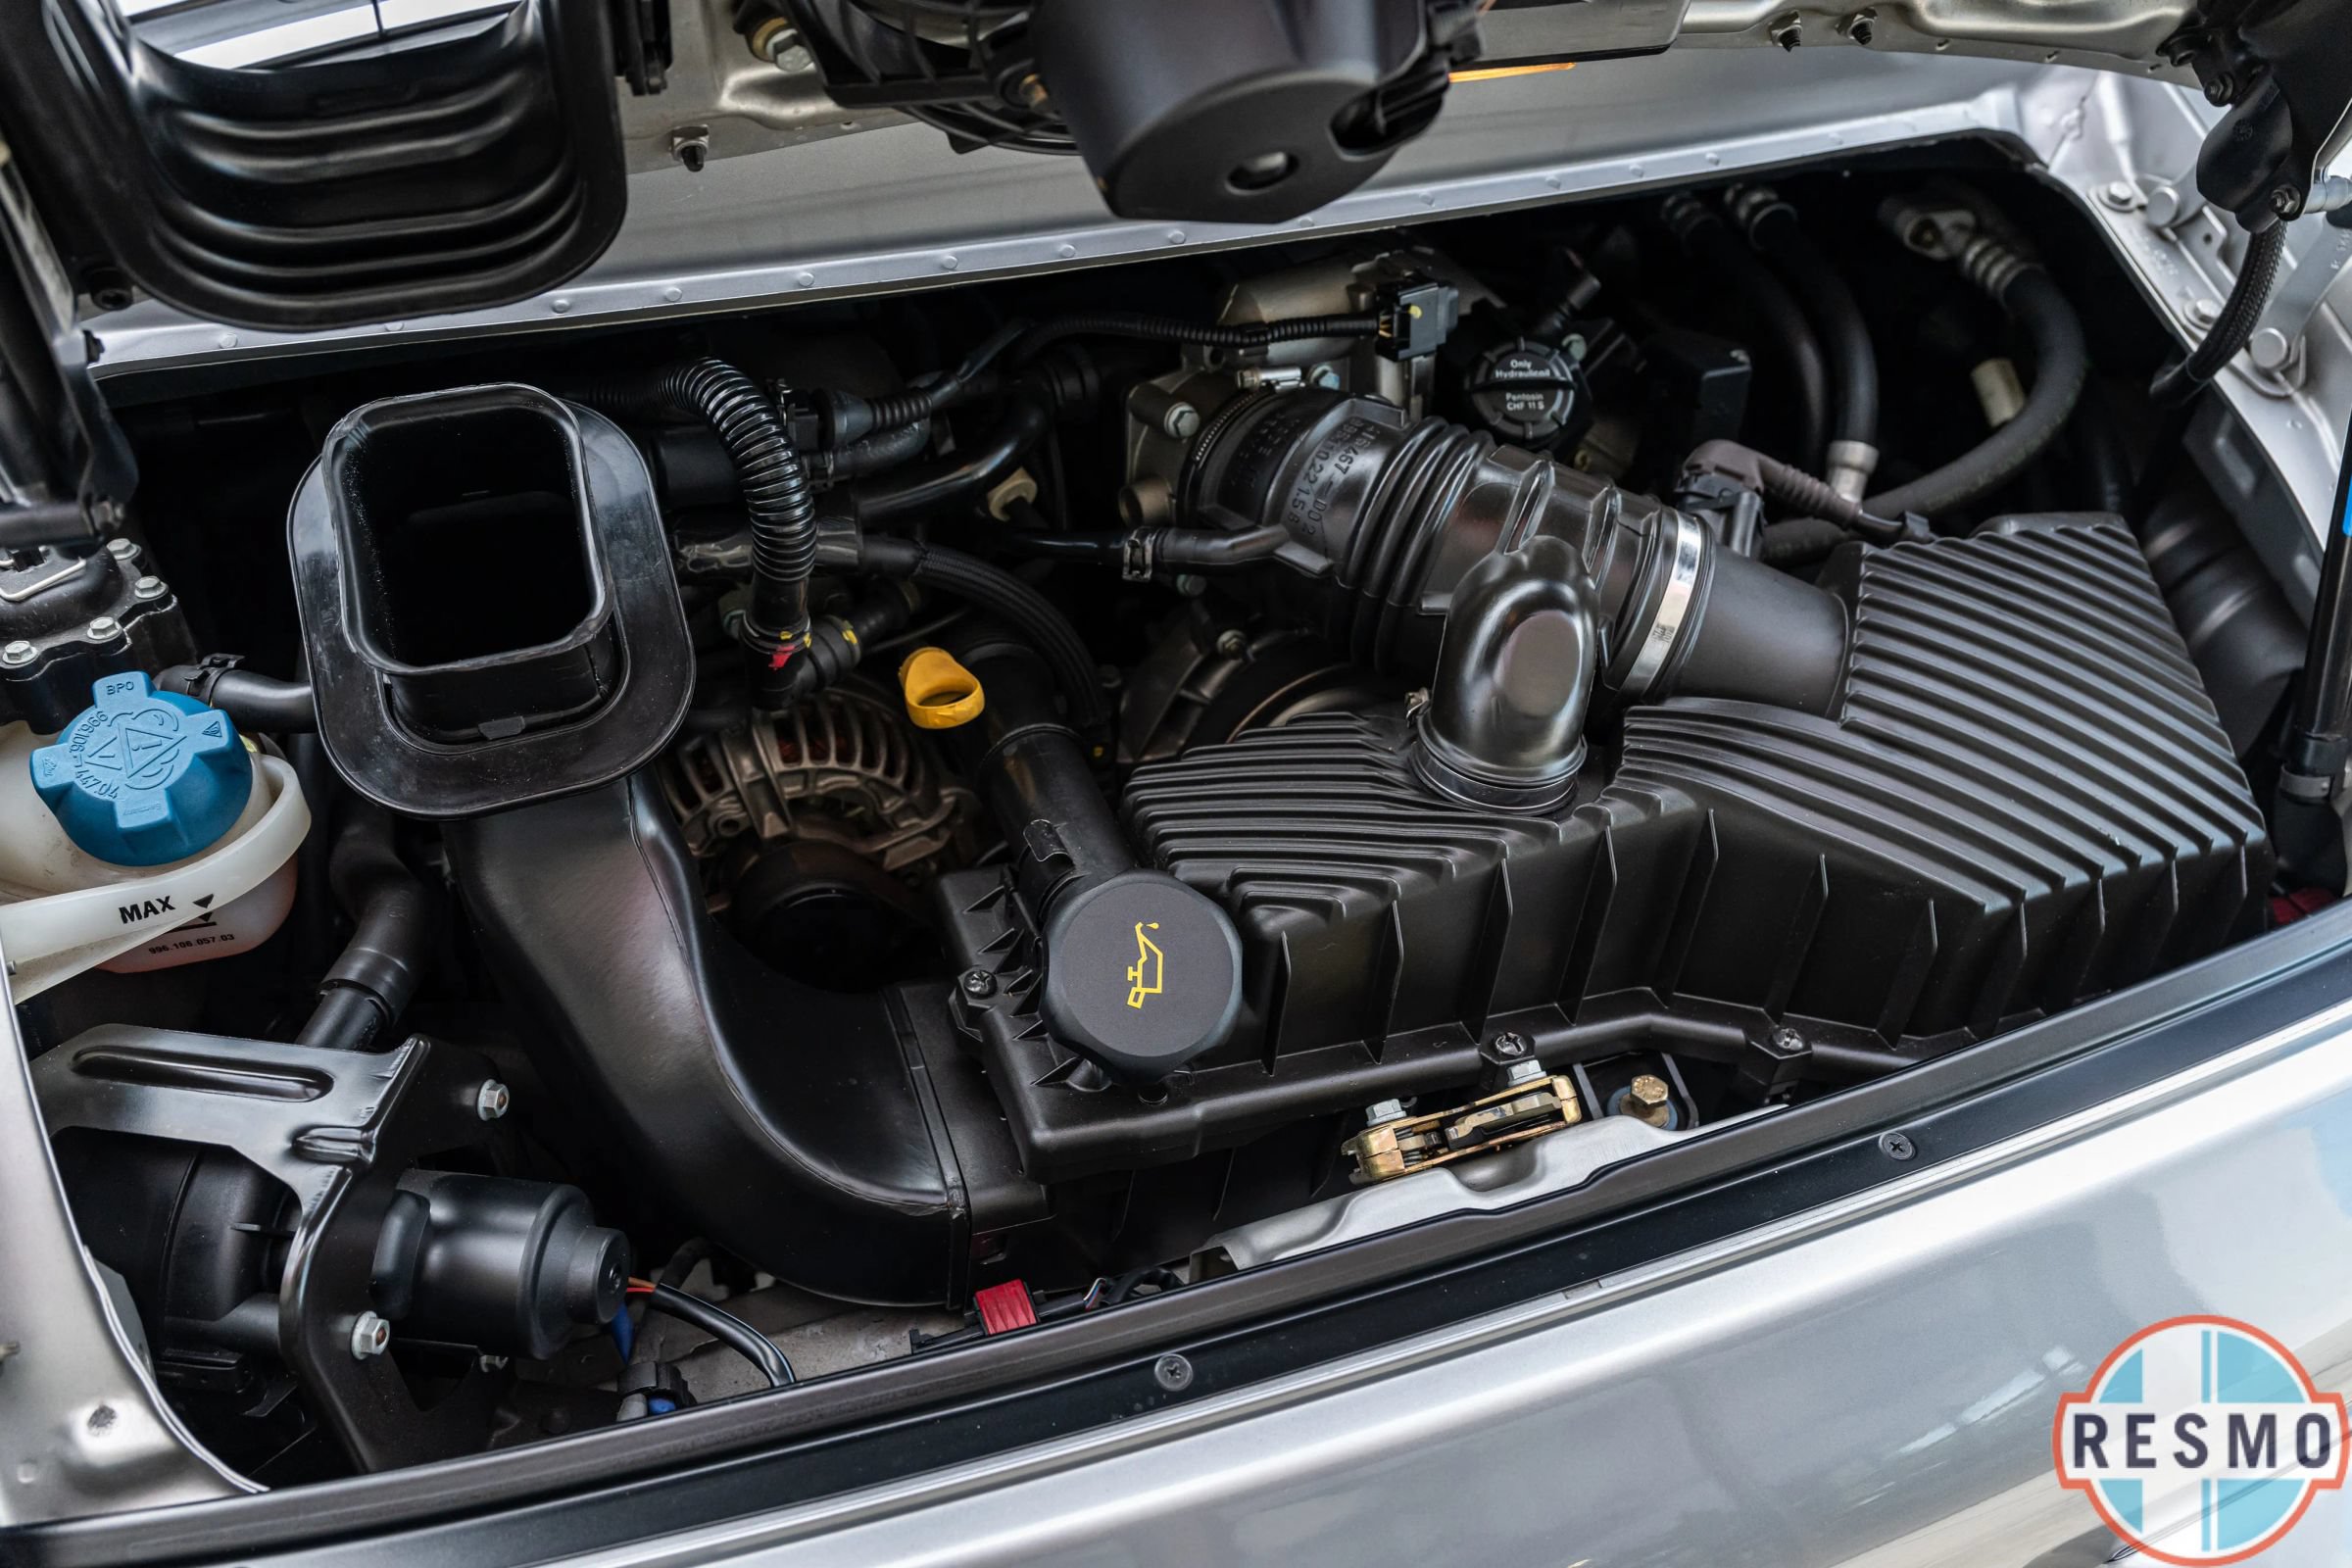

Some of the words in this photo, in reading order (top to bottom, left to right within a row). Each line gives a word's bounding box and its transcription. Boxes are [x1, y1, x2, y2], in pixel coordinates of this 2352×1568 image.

[1510, 359, 1532, 369] Only
[106, 681, 134, 695] BPO
[119, 896, 175, 924] MAX
